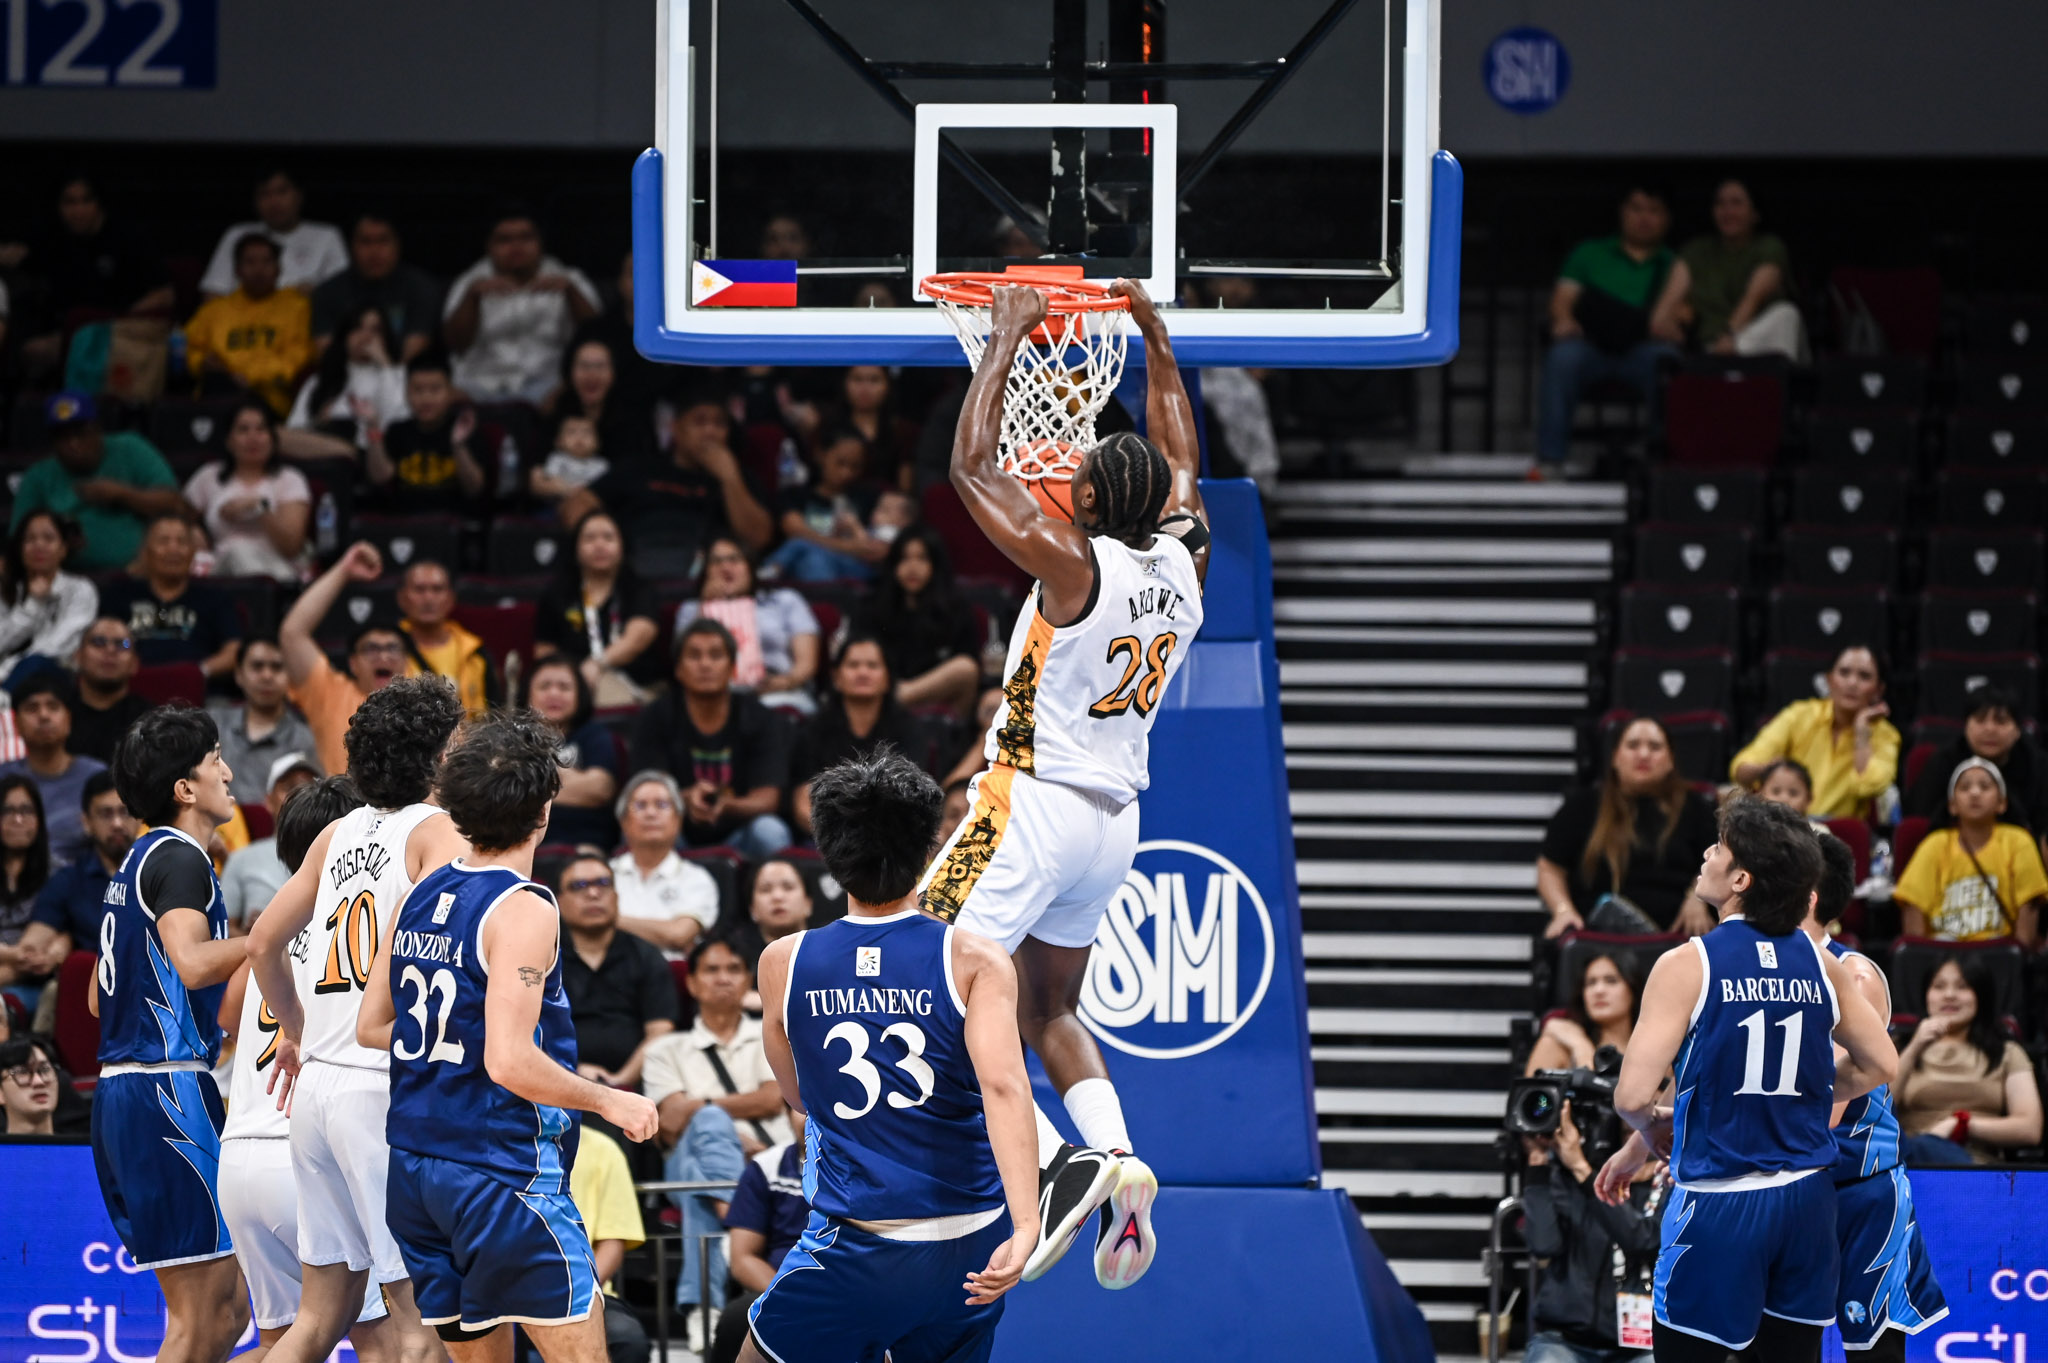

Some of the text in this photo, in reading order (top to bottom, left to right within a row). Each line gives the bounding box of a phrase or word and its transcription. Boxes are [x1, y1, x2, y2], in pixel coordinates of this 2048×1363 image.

[1129, 587, 1184, 623] AKOWE
[1088, 631, 1177, 719] 28
[98, 911, 116, 997] 8
[314, 889, 379, 994] 10
[1075, 868, 1238, 1028] SM
[393, 964, 466, 1065] 32
[805, 988, 933, 1017] TUMANENG
[1720, 977, 1823, 1004] BARCELONA
[823, 1021, 935, 1120] 33
[1733, 1008, 1803, 1096] 11
